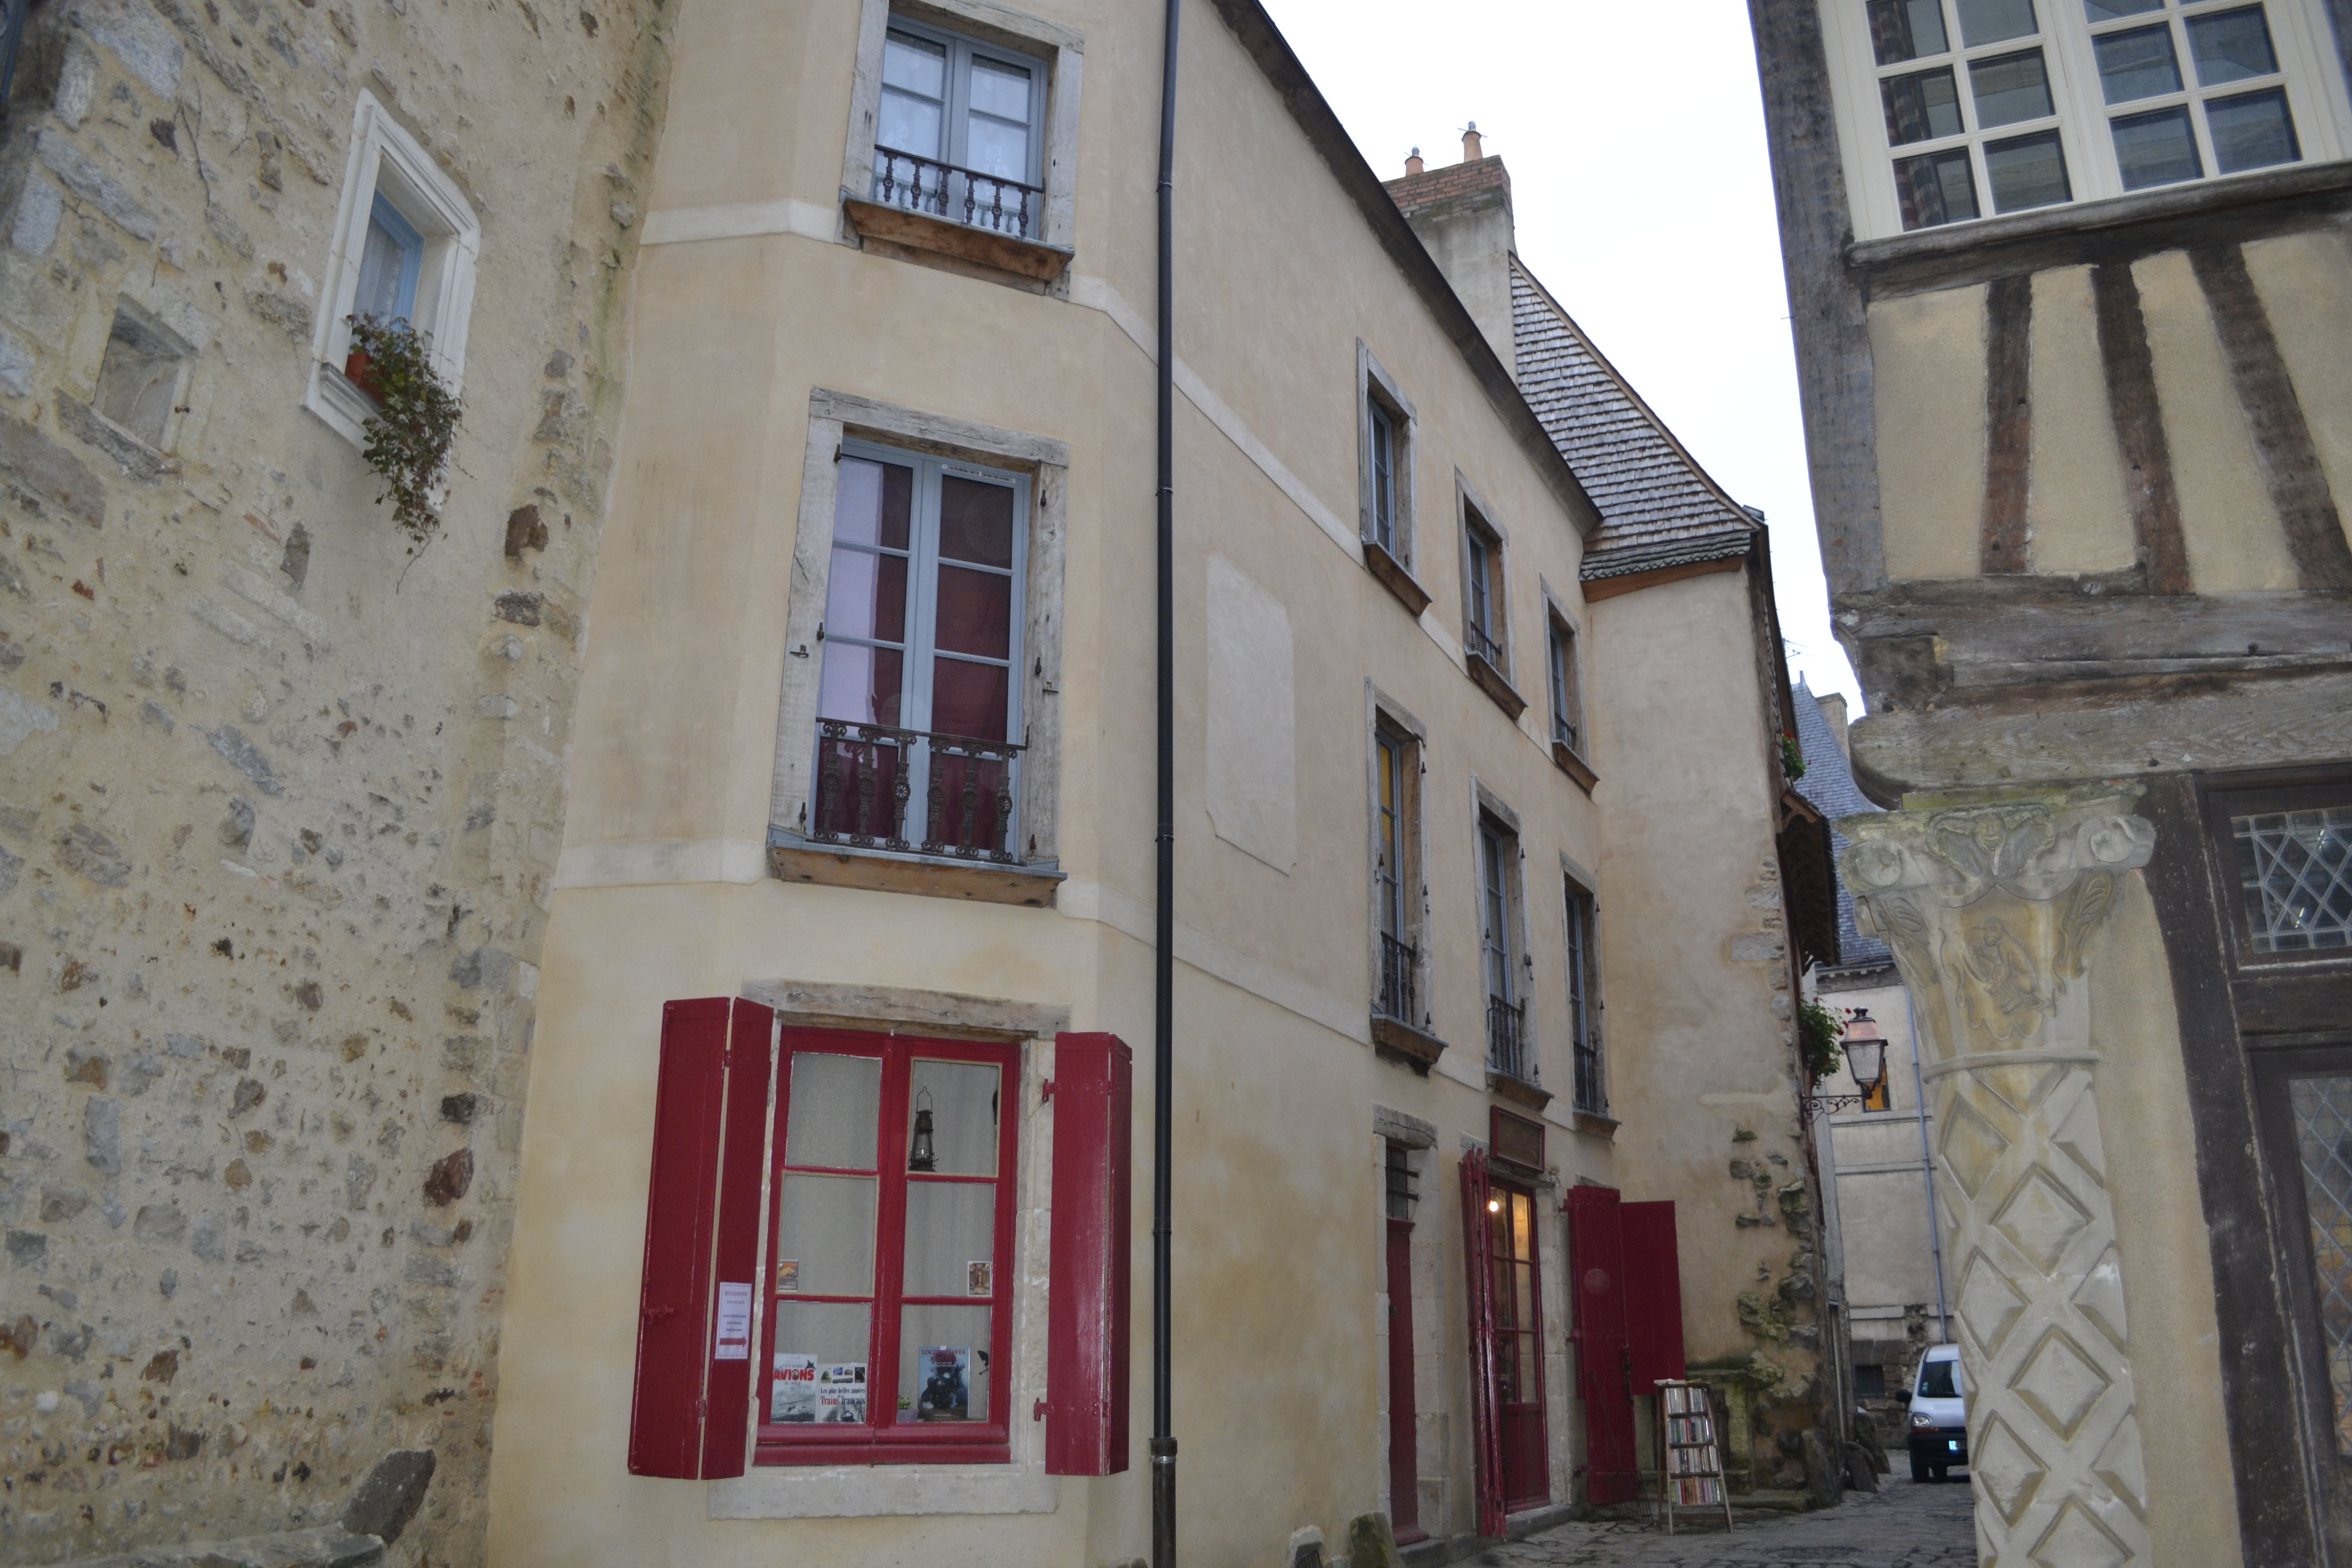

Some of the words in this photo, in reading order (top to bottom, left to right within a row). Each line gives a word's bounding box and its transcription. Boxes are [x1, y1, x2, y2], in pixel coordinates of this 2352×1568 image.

[773, 1369, 814, 1381] AVIONS
[829, 1387, 837, 1395] plus
[820, 1396, 840, 1405] Trains
